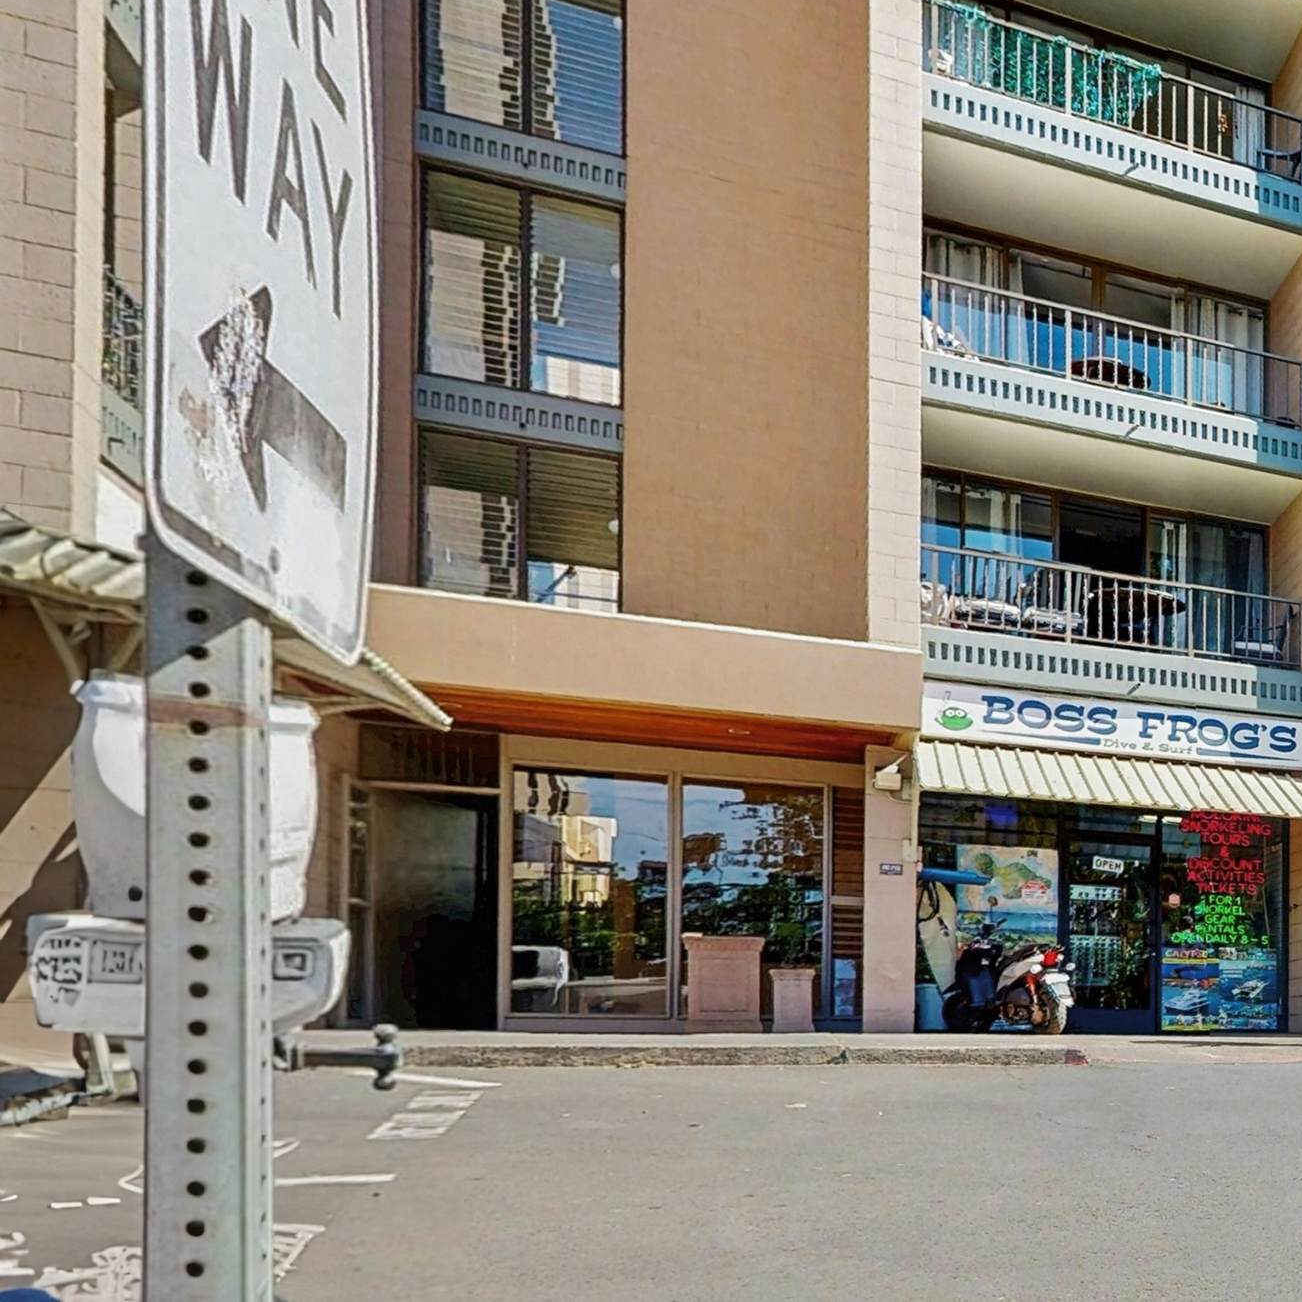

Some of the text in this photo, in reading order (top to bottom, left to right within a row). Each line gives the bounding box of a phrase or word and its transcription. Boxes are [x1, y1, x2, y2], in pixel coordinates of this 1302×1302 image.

[980, 695, 1298, 752] BOSS FROG'S
[1102, 738, 1196, 756] Dive & Surf
[1182, 819, 1273, 836] SNORKELING
[1201, 831, 1251, 847] TOURS
[1094, 859, 1122, 871] OPEN
[1188, 857, 1262, 870] DISCOUNT
[1187, 869, 1265, 884] ACTIVITIES
[1196, 882, 1257, 895] TICKETS
[1209, 895, 1233, 905] FOR
[1194, 904, 1246, 916] SNORKEL
[1204, 914, 1236, 925] GEAR
[1206, 933, 1238, 944] DAILY
[1241, 935, 1249, 945] 8
[1261, 935, 1269, 945] 5
